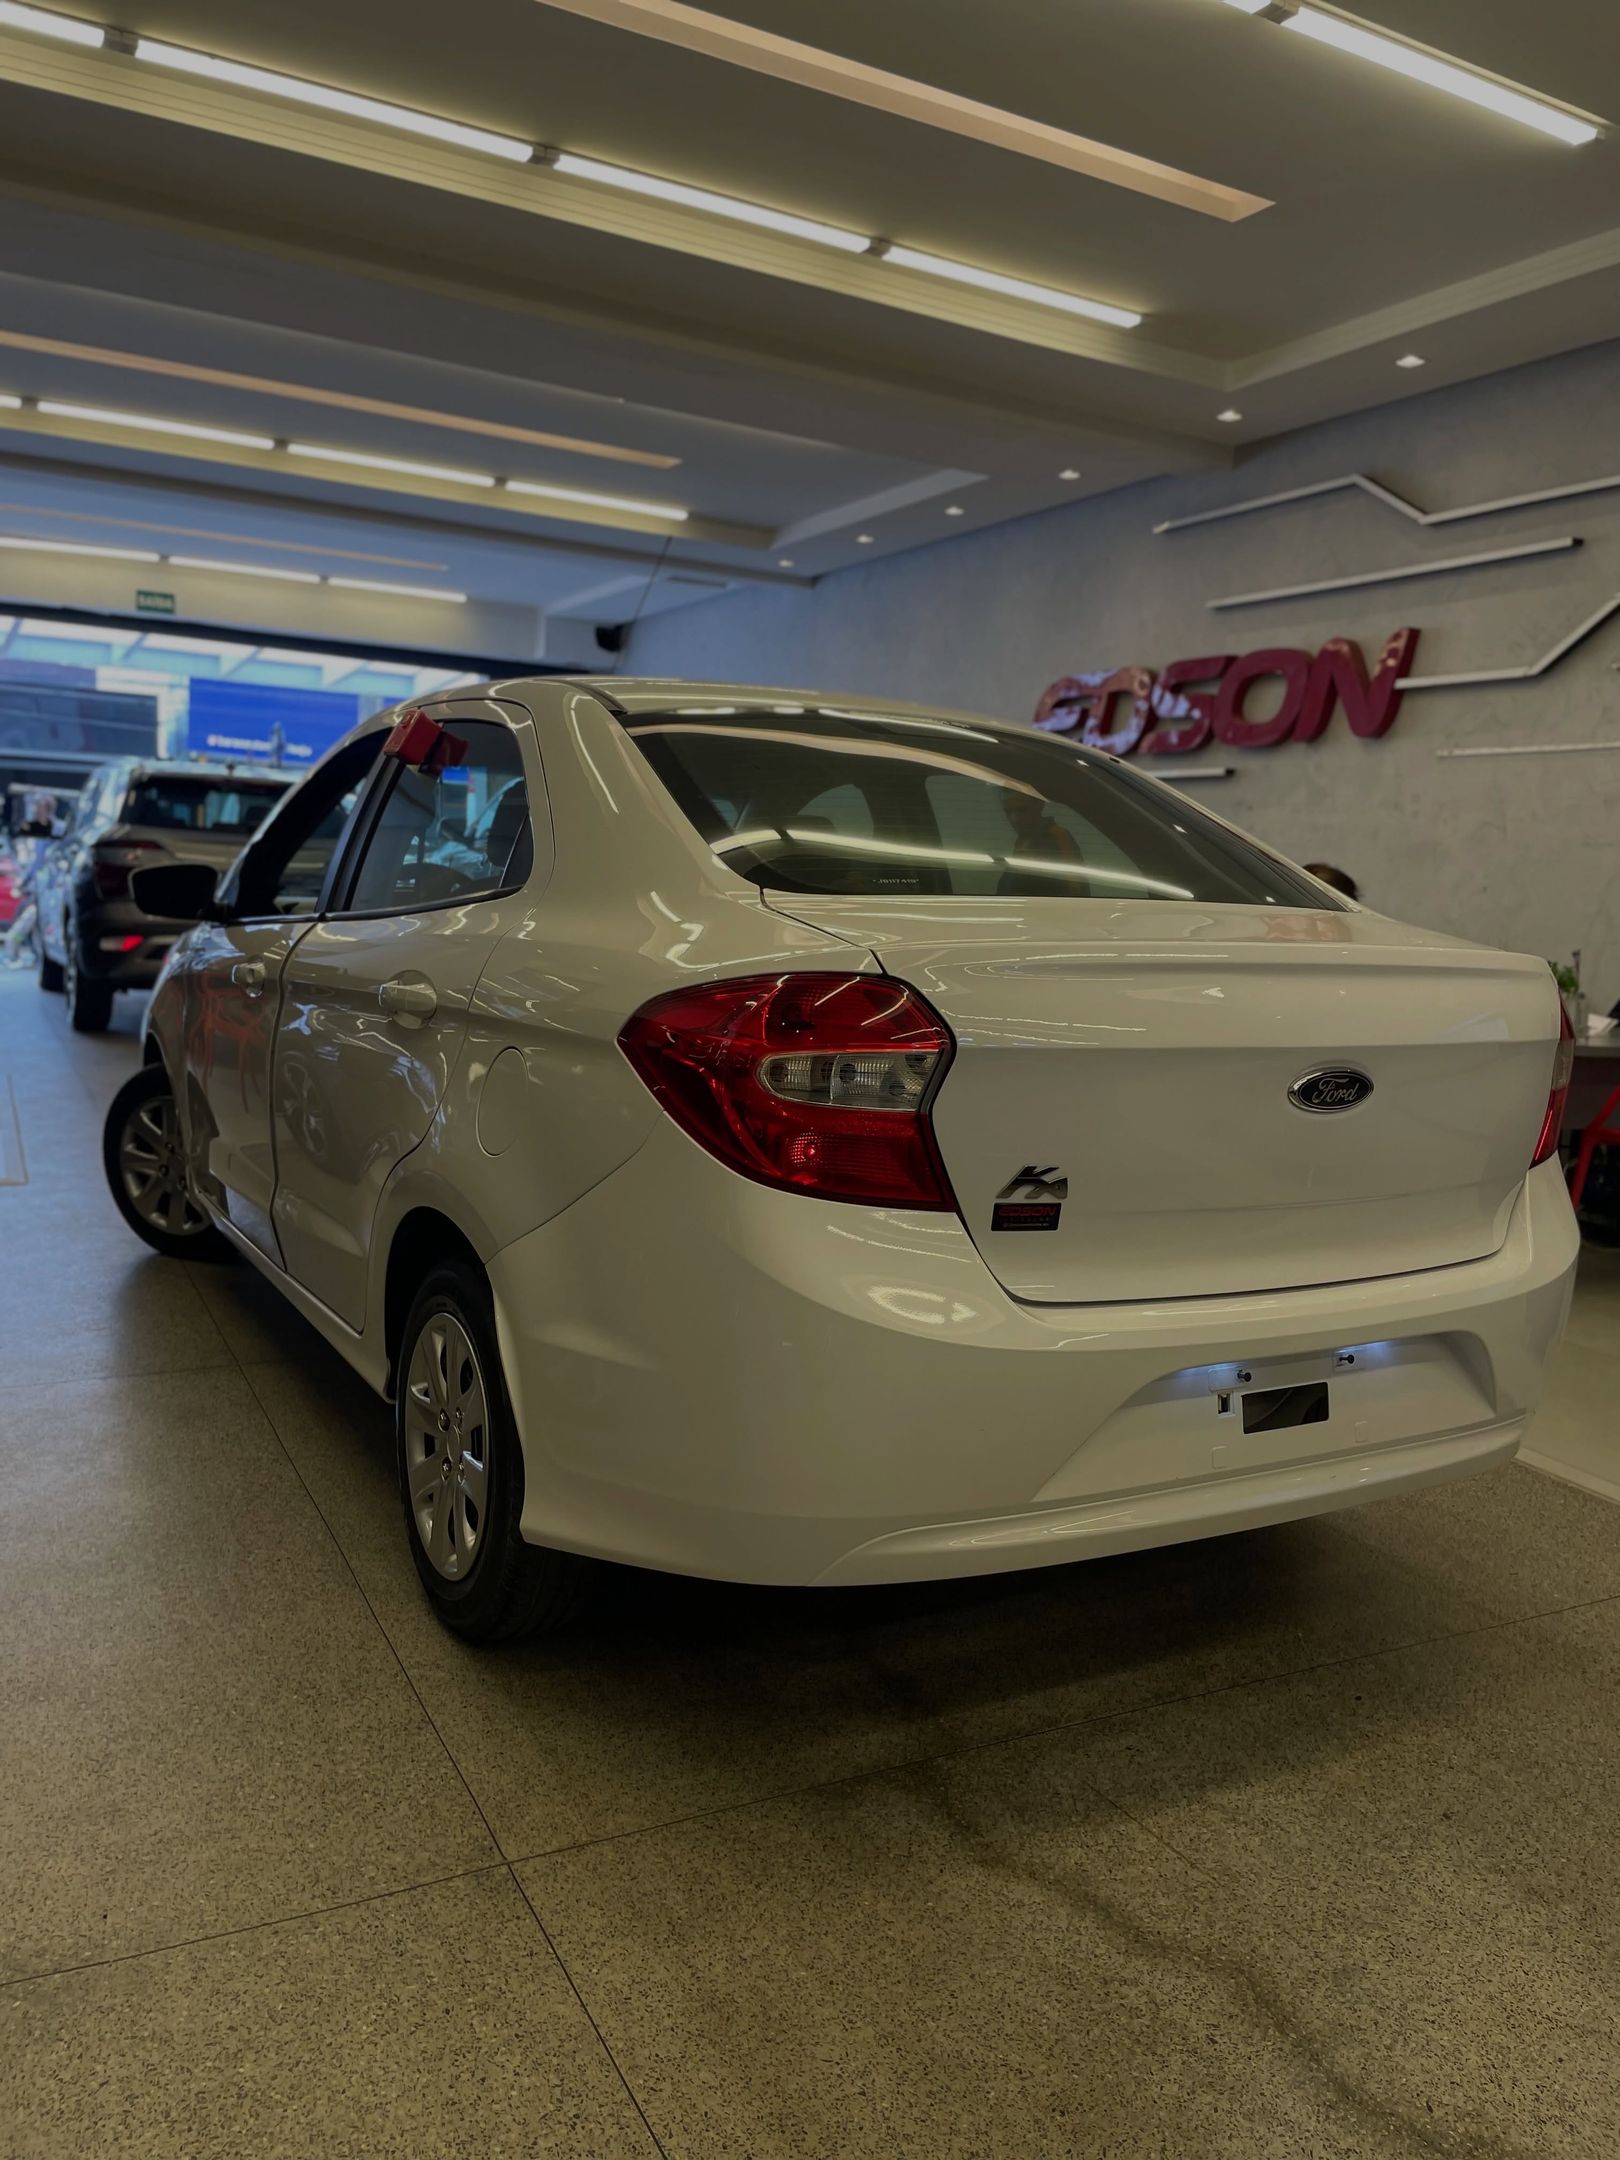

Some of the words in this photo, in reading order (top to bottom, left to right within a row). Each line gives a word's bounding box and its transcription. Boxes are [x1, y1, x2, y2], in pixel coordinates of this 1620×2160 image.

[1033, 627, 1421, 755] EDSON
[1312, 1077, 1360, 1104] Ford
[998, 1206, 1058, 1217] EDSON
